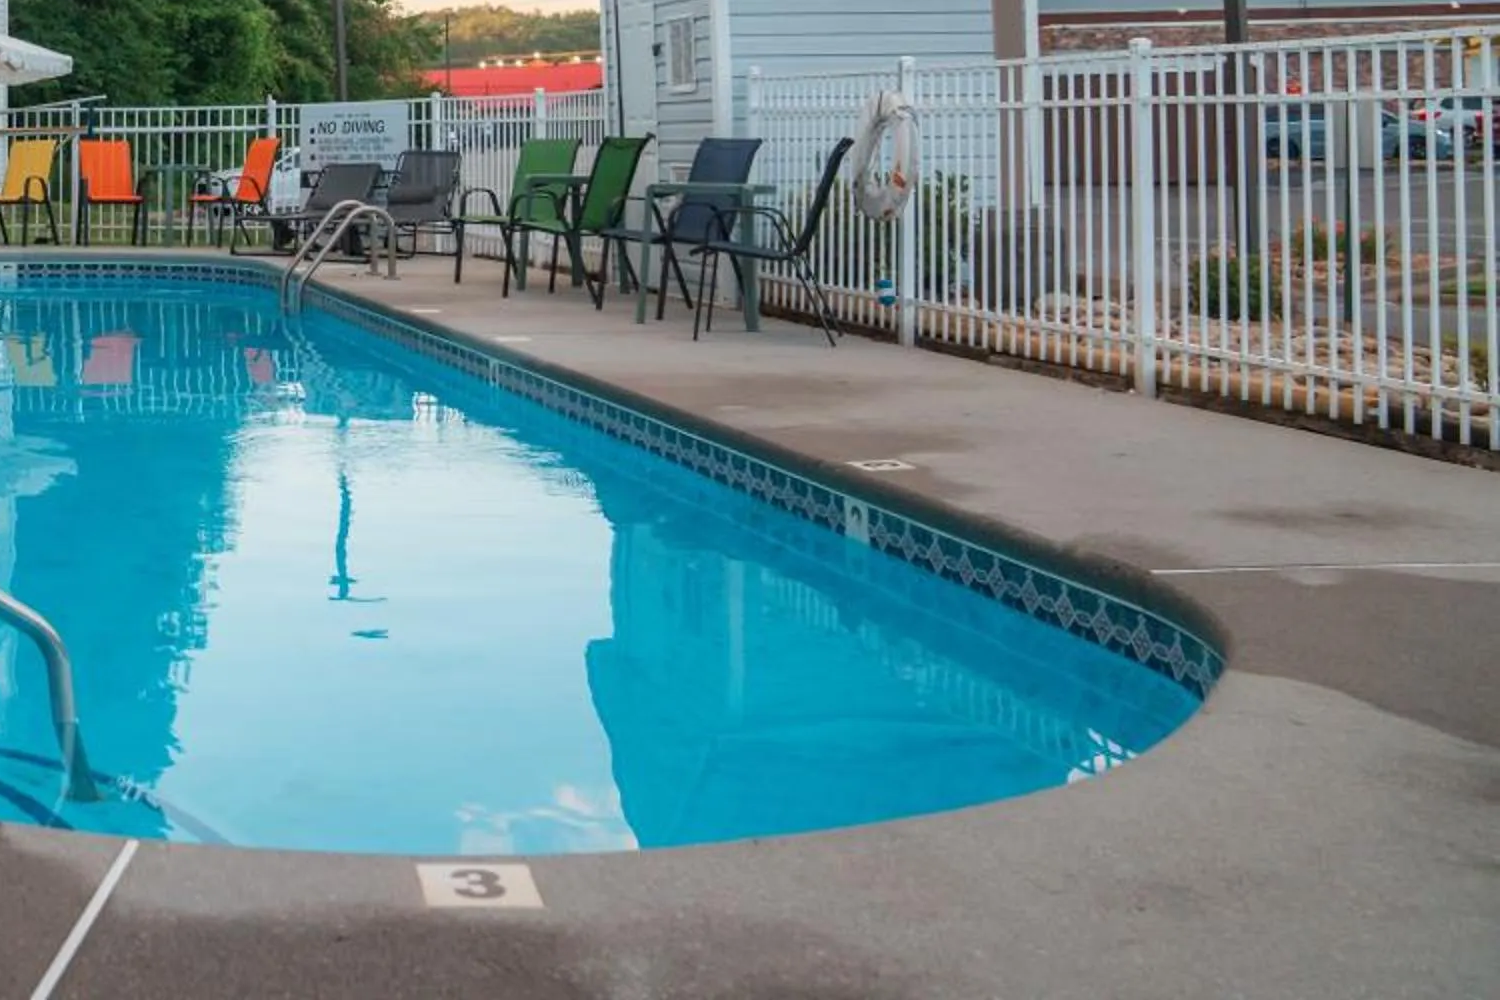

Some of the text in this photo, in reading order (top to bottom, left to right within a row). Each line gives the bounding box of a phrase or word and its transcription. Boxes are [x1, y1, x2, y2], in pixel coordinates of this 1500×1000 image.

[317, 119, 385, 134] NO DIVING
[451, 868, 506, 899] 3
